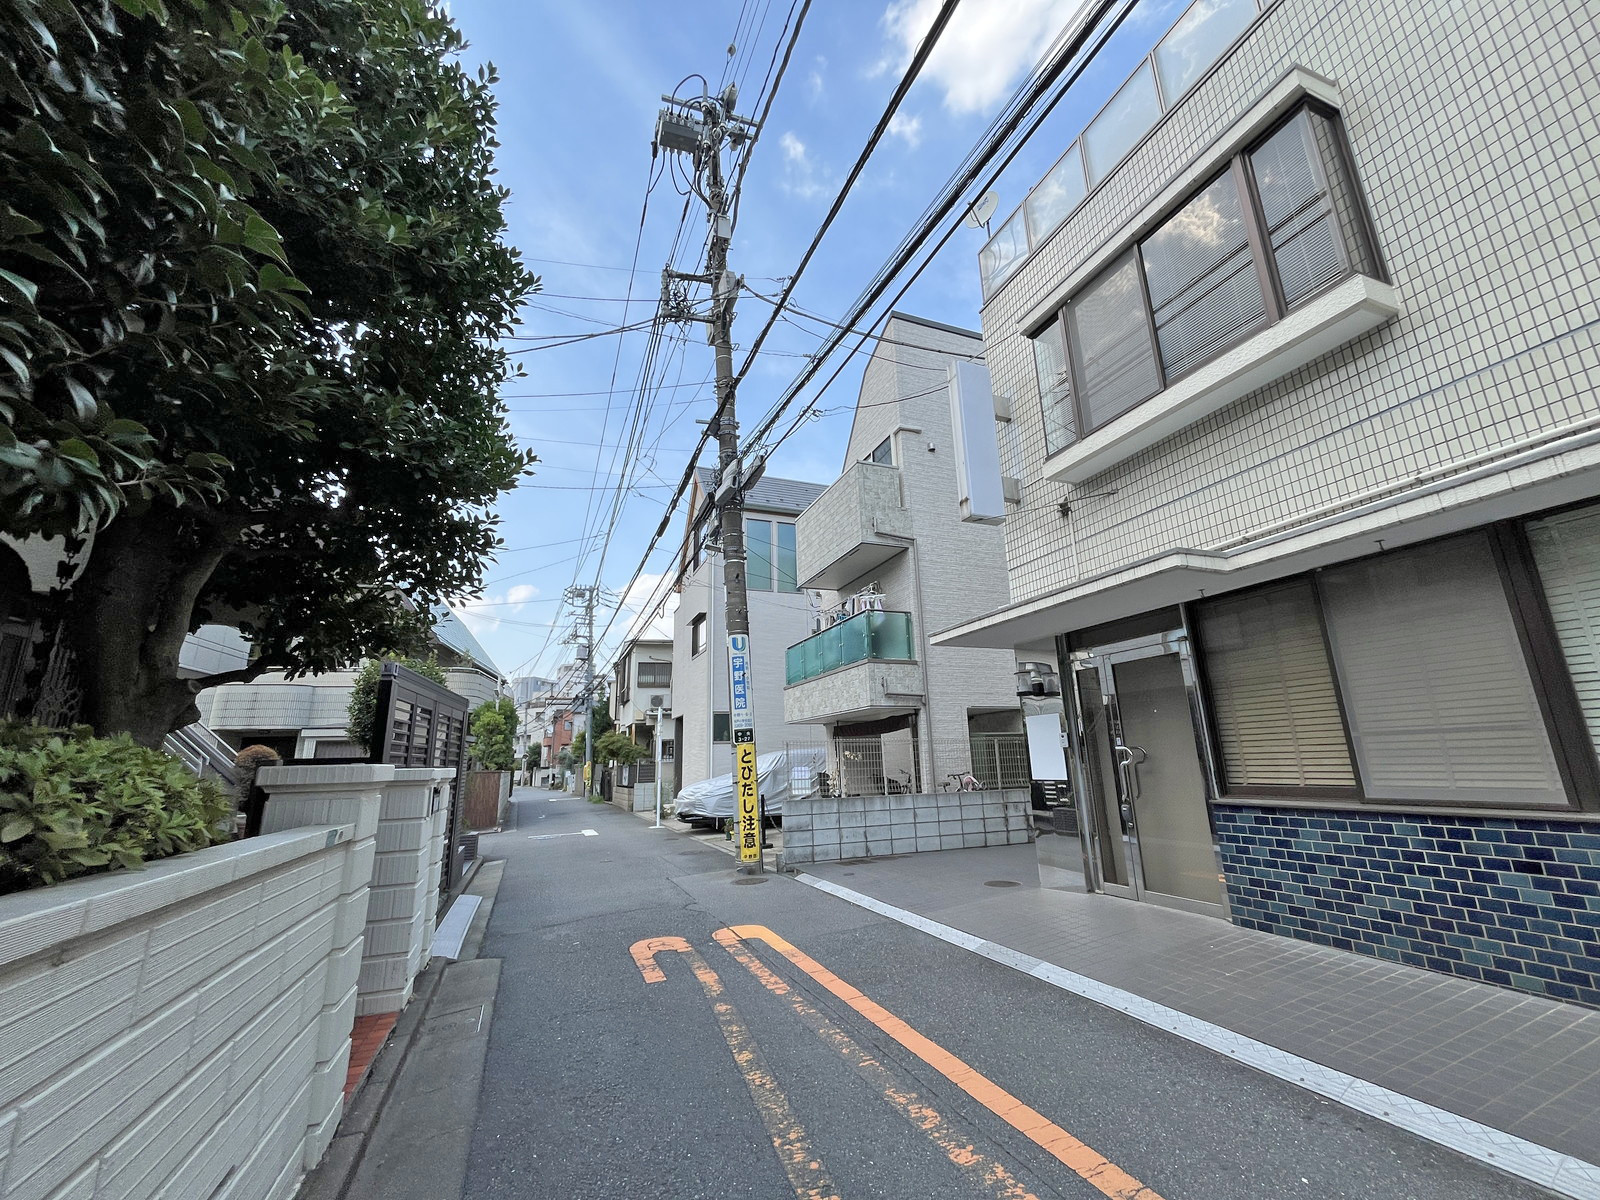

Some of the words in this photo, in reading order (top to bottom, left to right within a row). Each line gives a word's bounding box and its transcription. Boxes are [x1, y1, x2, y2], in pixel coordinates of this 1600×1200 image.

[733, 657, 746, 708] 宇野医院
[741, 749, 756, 849] とびだし注意
